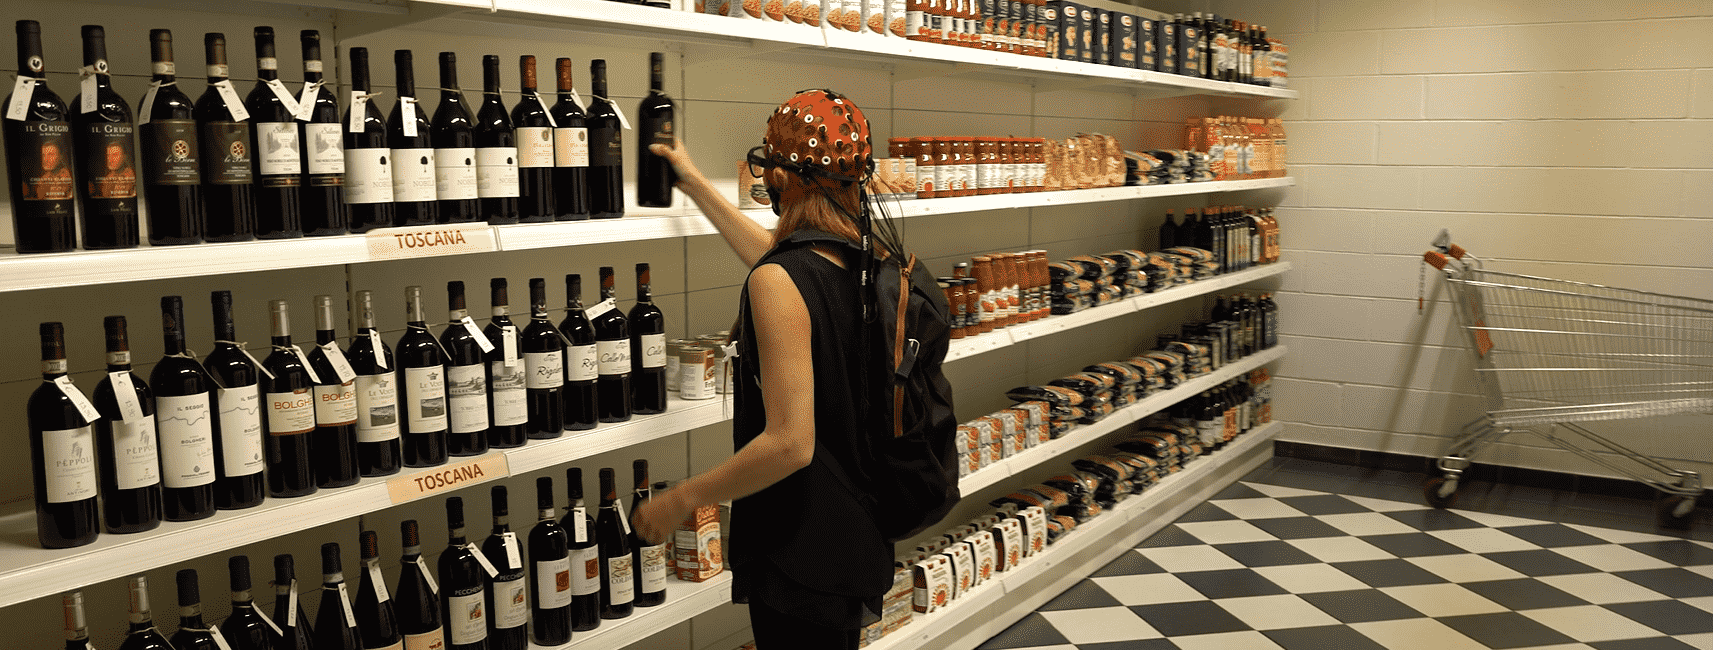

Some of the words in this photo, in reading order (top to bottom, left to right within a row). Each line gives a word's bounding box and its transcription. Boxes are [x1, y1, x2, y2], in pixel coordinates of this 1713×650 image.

[39, 123, 69, 133] GRIGIO
[104, 124, 132, 134] GRIGIO
[394, 230, 466, 249] TOSCANA
[414, 463, 484, 493] TOSCANA
